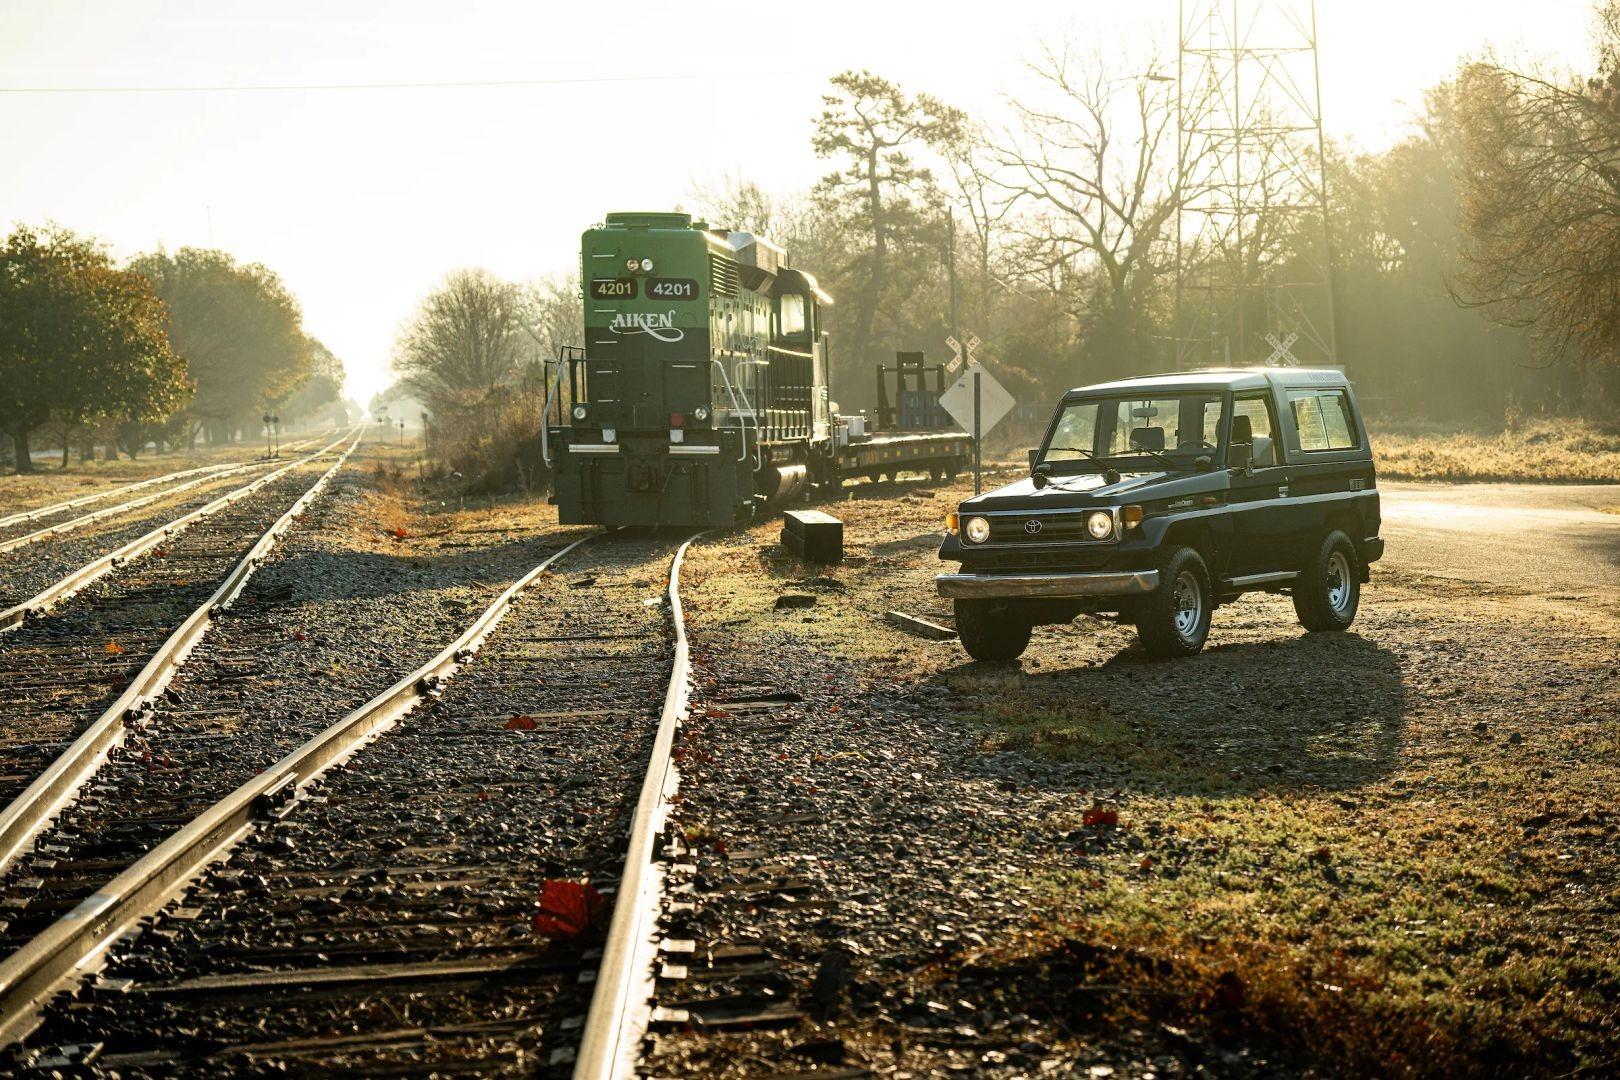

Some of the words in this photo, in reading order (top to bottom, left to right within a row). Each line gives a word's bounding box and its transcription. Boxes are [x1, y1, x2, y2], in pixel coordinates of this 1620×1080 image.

[598, 282, 632, 295] 4201
[654, 283, 691, 296] 4201
[609, 310, 684, 342] AIKEN
